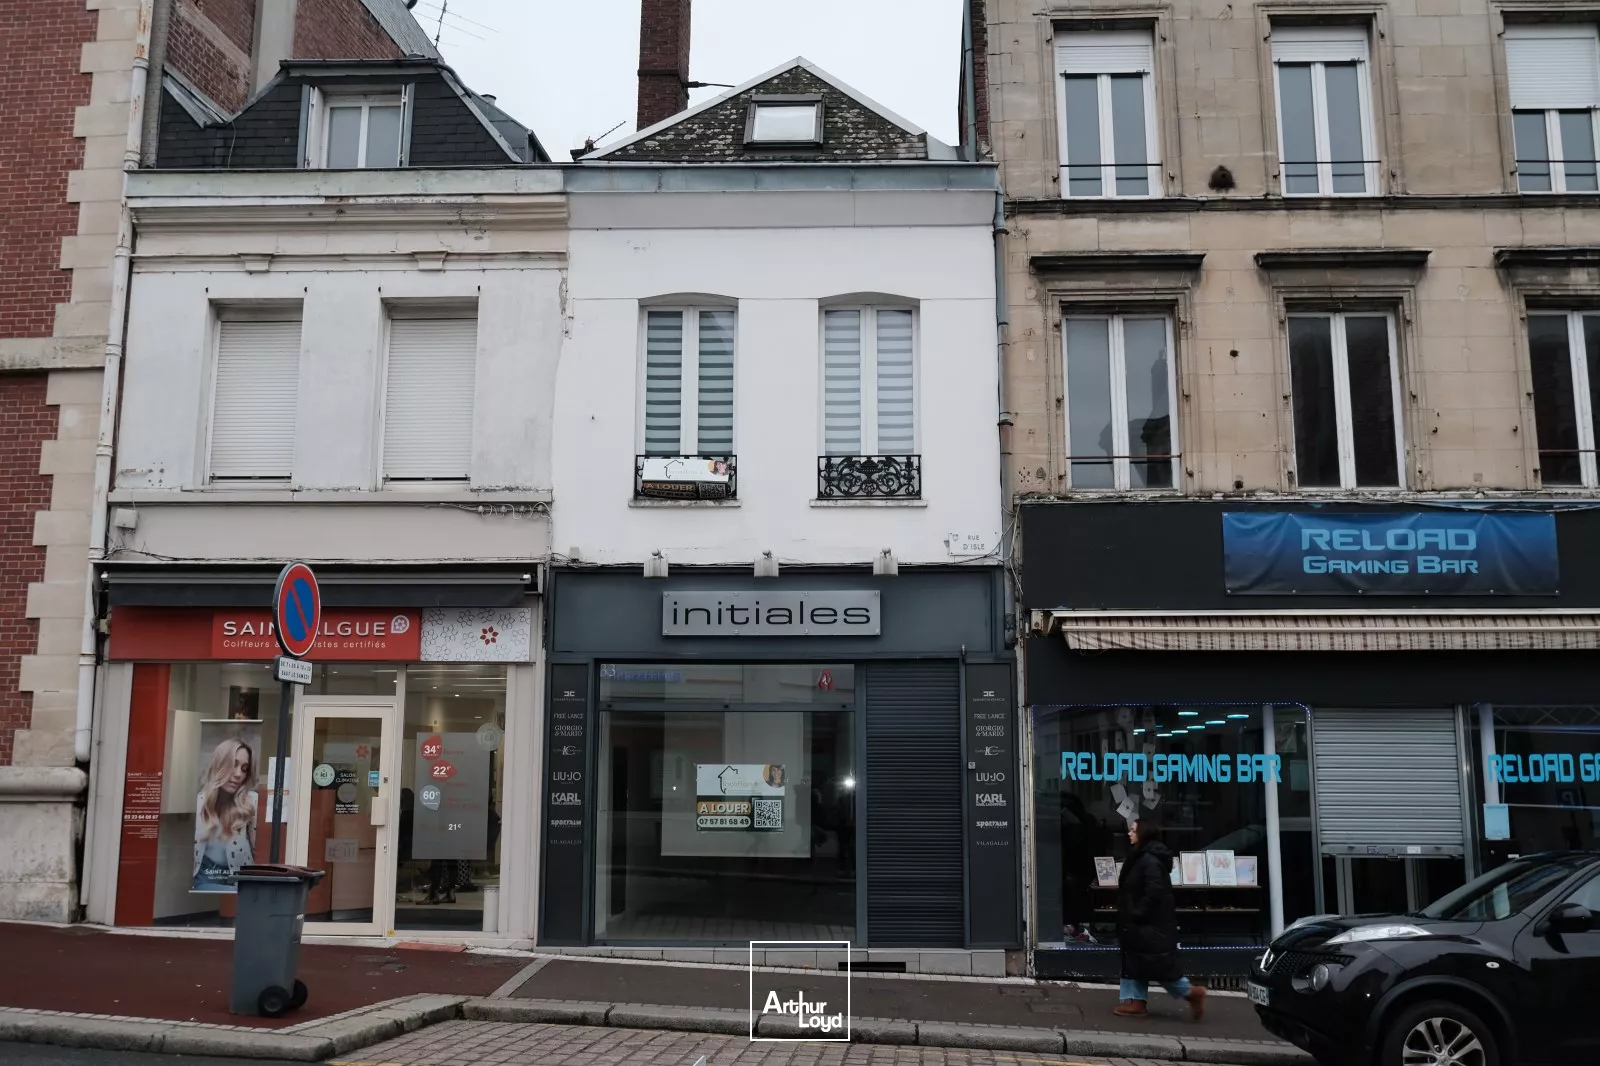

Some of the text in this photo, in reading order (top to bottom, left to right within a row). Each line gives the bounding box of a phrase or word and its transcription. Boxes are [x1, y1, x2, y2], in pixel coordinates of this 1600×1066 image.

[656, 483, 693, 491] LOUER
[1301, 528, 1477, 551] RELOAD
[673, 600, 871, 625] initiales
[223, 640, 270, 648] Coiffeurs
[343, 640, 386, 648] certifiés
[1061, 751, 1282, 783] RELOAD GAMING BAR
[1487, 753, 1575, 783] RELOAD
[551, 792, 582, 802] KARL
[975, 793, 1007, 803] KARL
[700, 803, 749, 814] A LOUER
